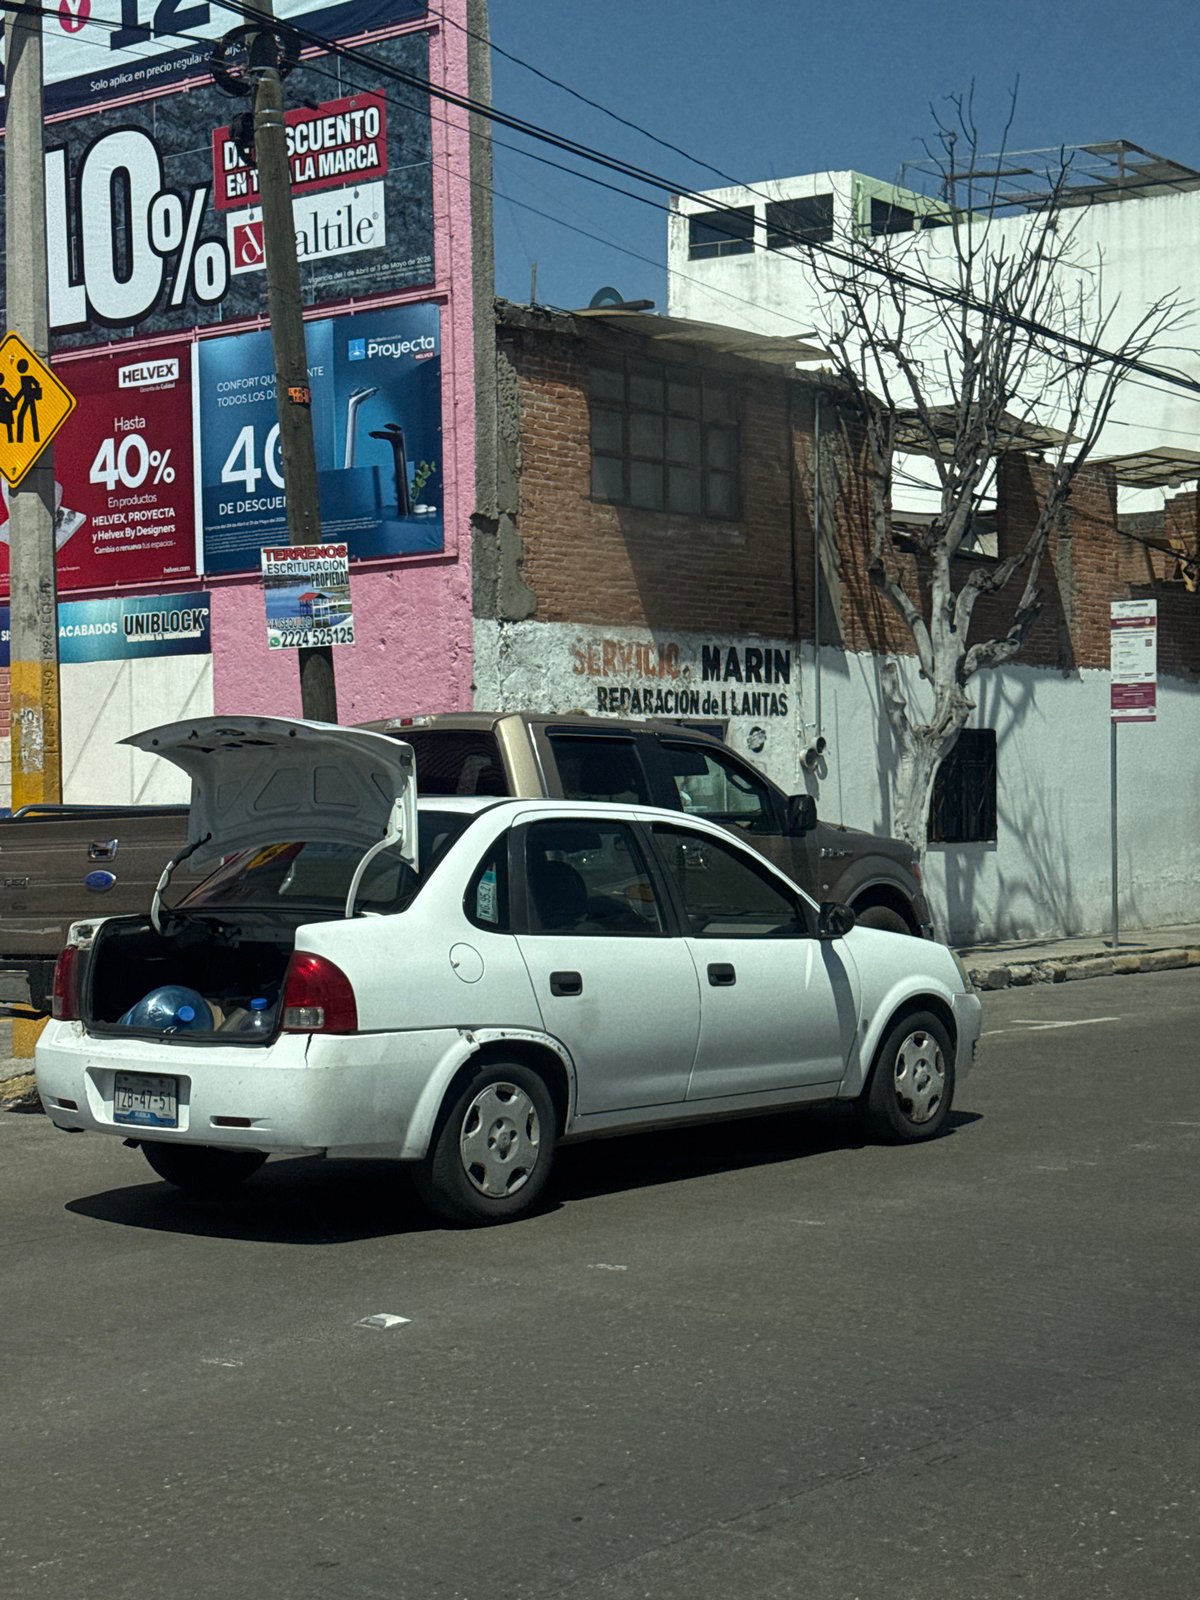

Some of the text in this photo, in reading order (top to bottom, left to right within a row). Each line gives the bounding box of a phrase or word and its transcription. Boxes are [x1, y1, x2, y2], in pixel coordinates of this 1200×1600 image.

[90, 53, 202, 92] Solo aplica en precio regular
[226, 171, 247, 198] EN
[295, 156, 316, 183] LA
[318, 142, 379, 178] MARCA
[356, 266, 369, 276] Abril
[390, 261, 407, 271] Mayo
[368, 335, 435, 358] Proyecta
[122, 363, 174, 384] HELVEX
[216, 376, 259, 392] CONFORT
[217, 394, 246, 407] TODOS
[248, 391, 265, 403] LOS
[114, 416, 146, 432] Hasta
[89, 433, 176, 491] 40%
[108, 494, 158, 510] En productos
[219, 502, 234, 516] DE
[128, 508, 176, 522] PROYECTA
[92, 524, 176, 544] y Helvex By Designers
[263, 545, 348, 562] TERRENOS
[163, 566, 190, 574] helvex.com
[310, 571, 349, 588] PROPIEDAD
[58, 622, 118, 638] ACABADOS
[281, 627, 354, 648] 2224 525125
[702, 645, 790, 684] MARIN
[597, 686, 700, 715] REPARACION
[702, 690, 718, 716] de
